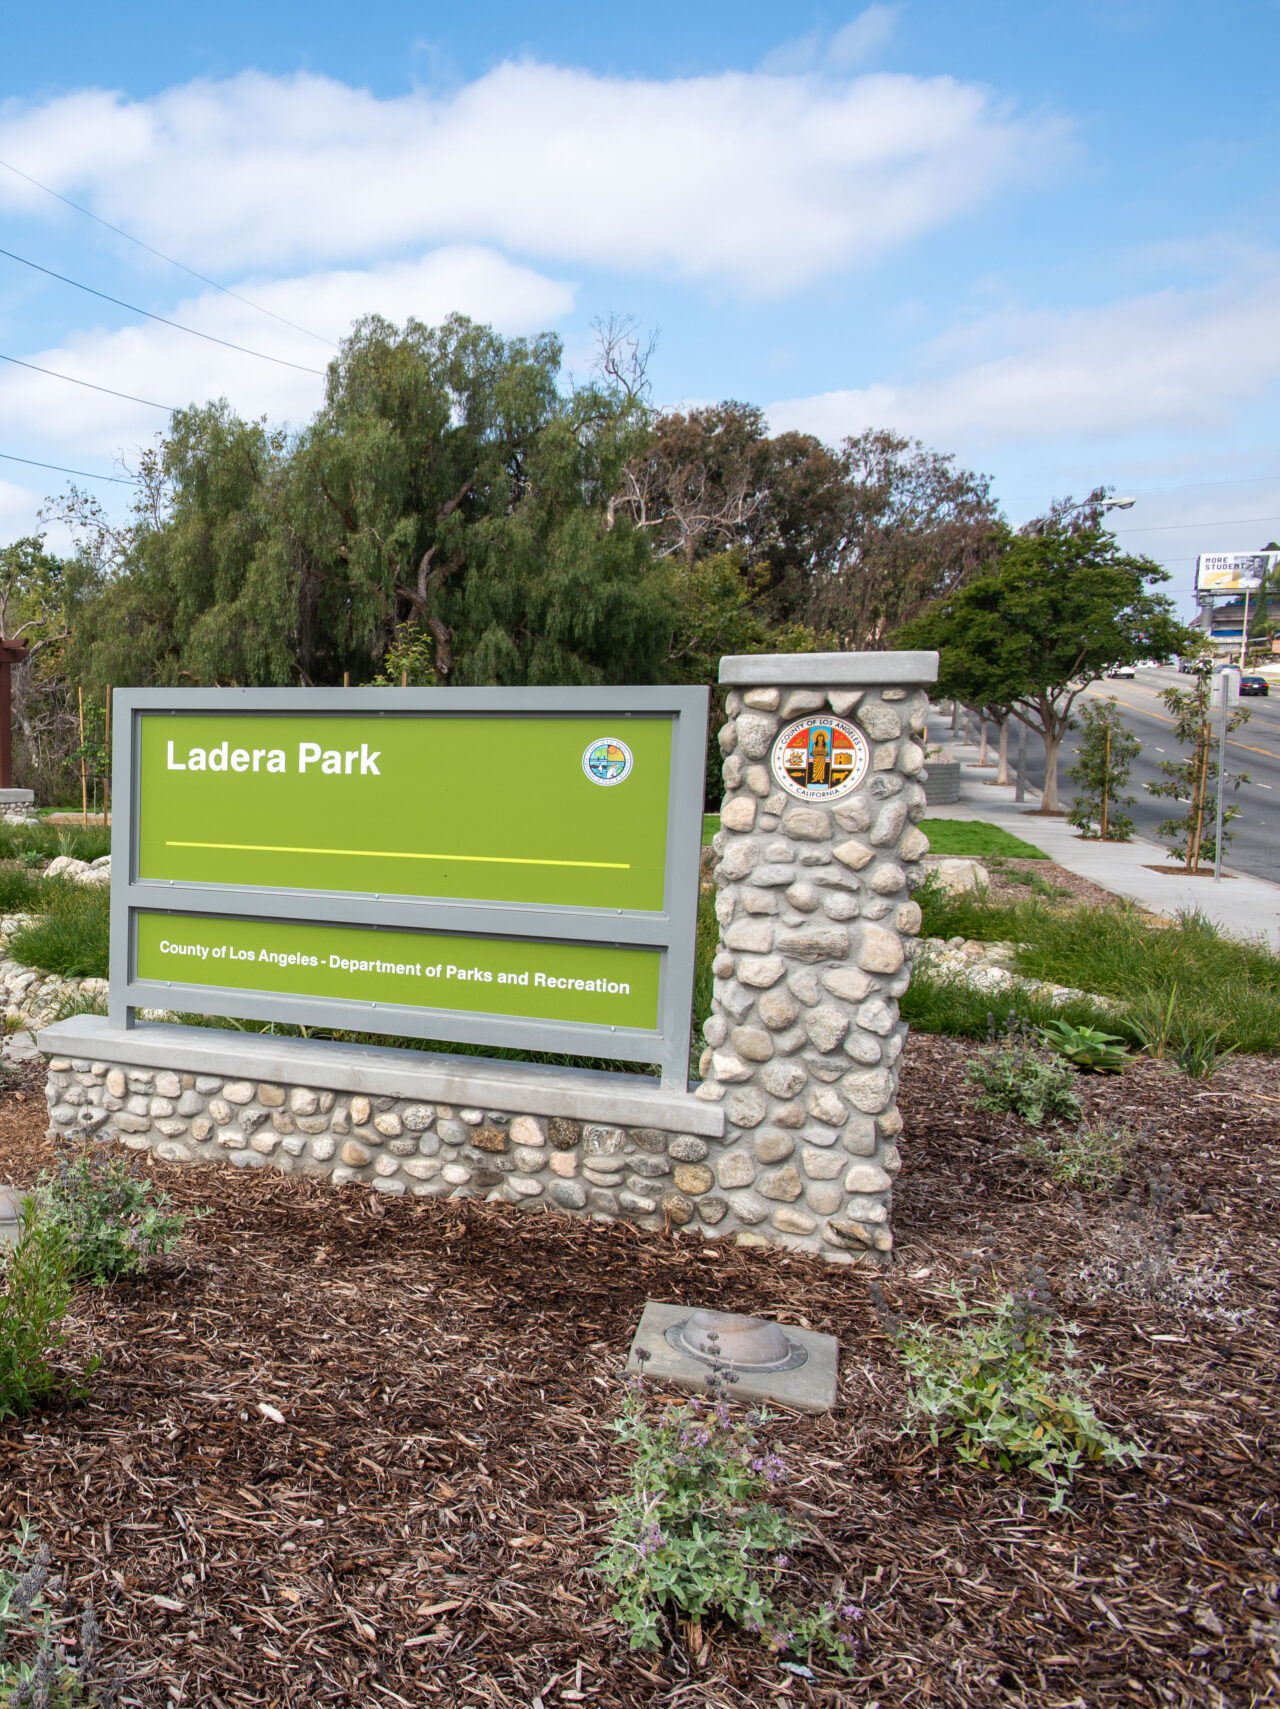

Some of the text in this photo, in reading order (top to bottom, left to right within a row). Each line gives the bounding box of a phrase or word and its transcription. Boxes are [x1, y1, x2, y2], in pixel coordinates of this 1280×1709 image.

[781, 723, 804, 745] COUNTY
[806, 719, 817, 727] OF
[835, 722, 861, 746] ANGELES
[166, 739, 382, 776] Ladera Park
[796, 787, 840, 798] CALIFORNIA
[159, 939, 210, 961] County
[211, 945, 227, 959] of
[229, 945, 256, 962] Los
[257, 948, 319, 968] Angeles
[329, 954, 422, 977] Department
[425, 963, 443, 978] of
[445, 964, 494, 983] Parks
[496, 970, 530, 986] and
[533, 972, 631, 995] Recreation
